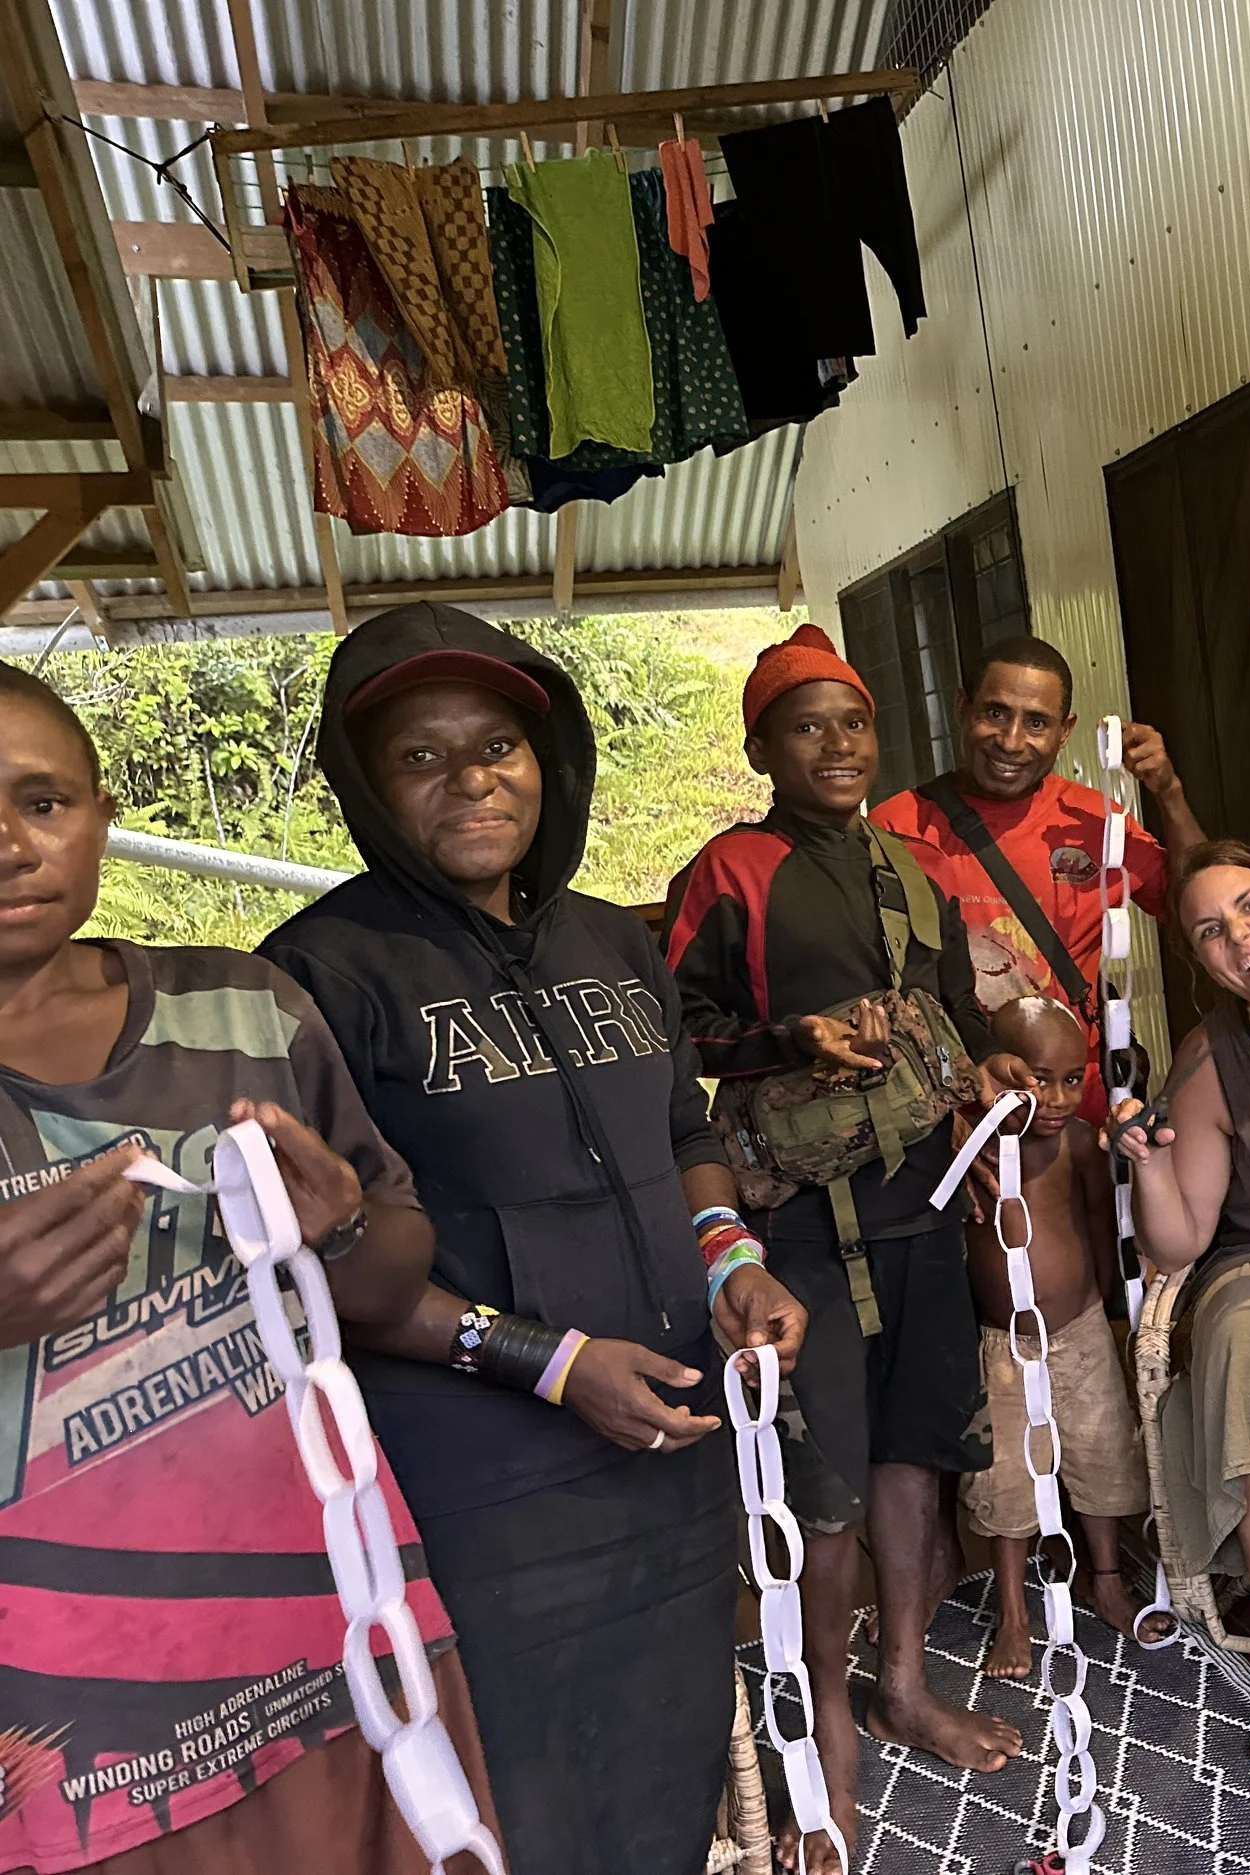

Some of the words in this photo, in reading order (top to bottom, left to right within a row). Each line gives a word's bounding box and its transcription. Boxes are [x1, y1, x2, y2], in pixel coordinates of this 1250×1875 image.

[174, 1710, 222, 1739] HIGH
[219, 1660, 307, 1719] ADRENALINE
[265, 1671, 334, 1716] UNMATCHED
[62, 1750, 174, 1802] WINDING
[181, 1711, 252, 1763] ROADS
[131, 1770, 191, 1804] SUPER
[196, 1730, 266, 1780] EXTREME
[267, 1692, 332, 1738] CIRCUITS
